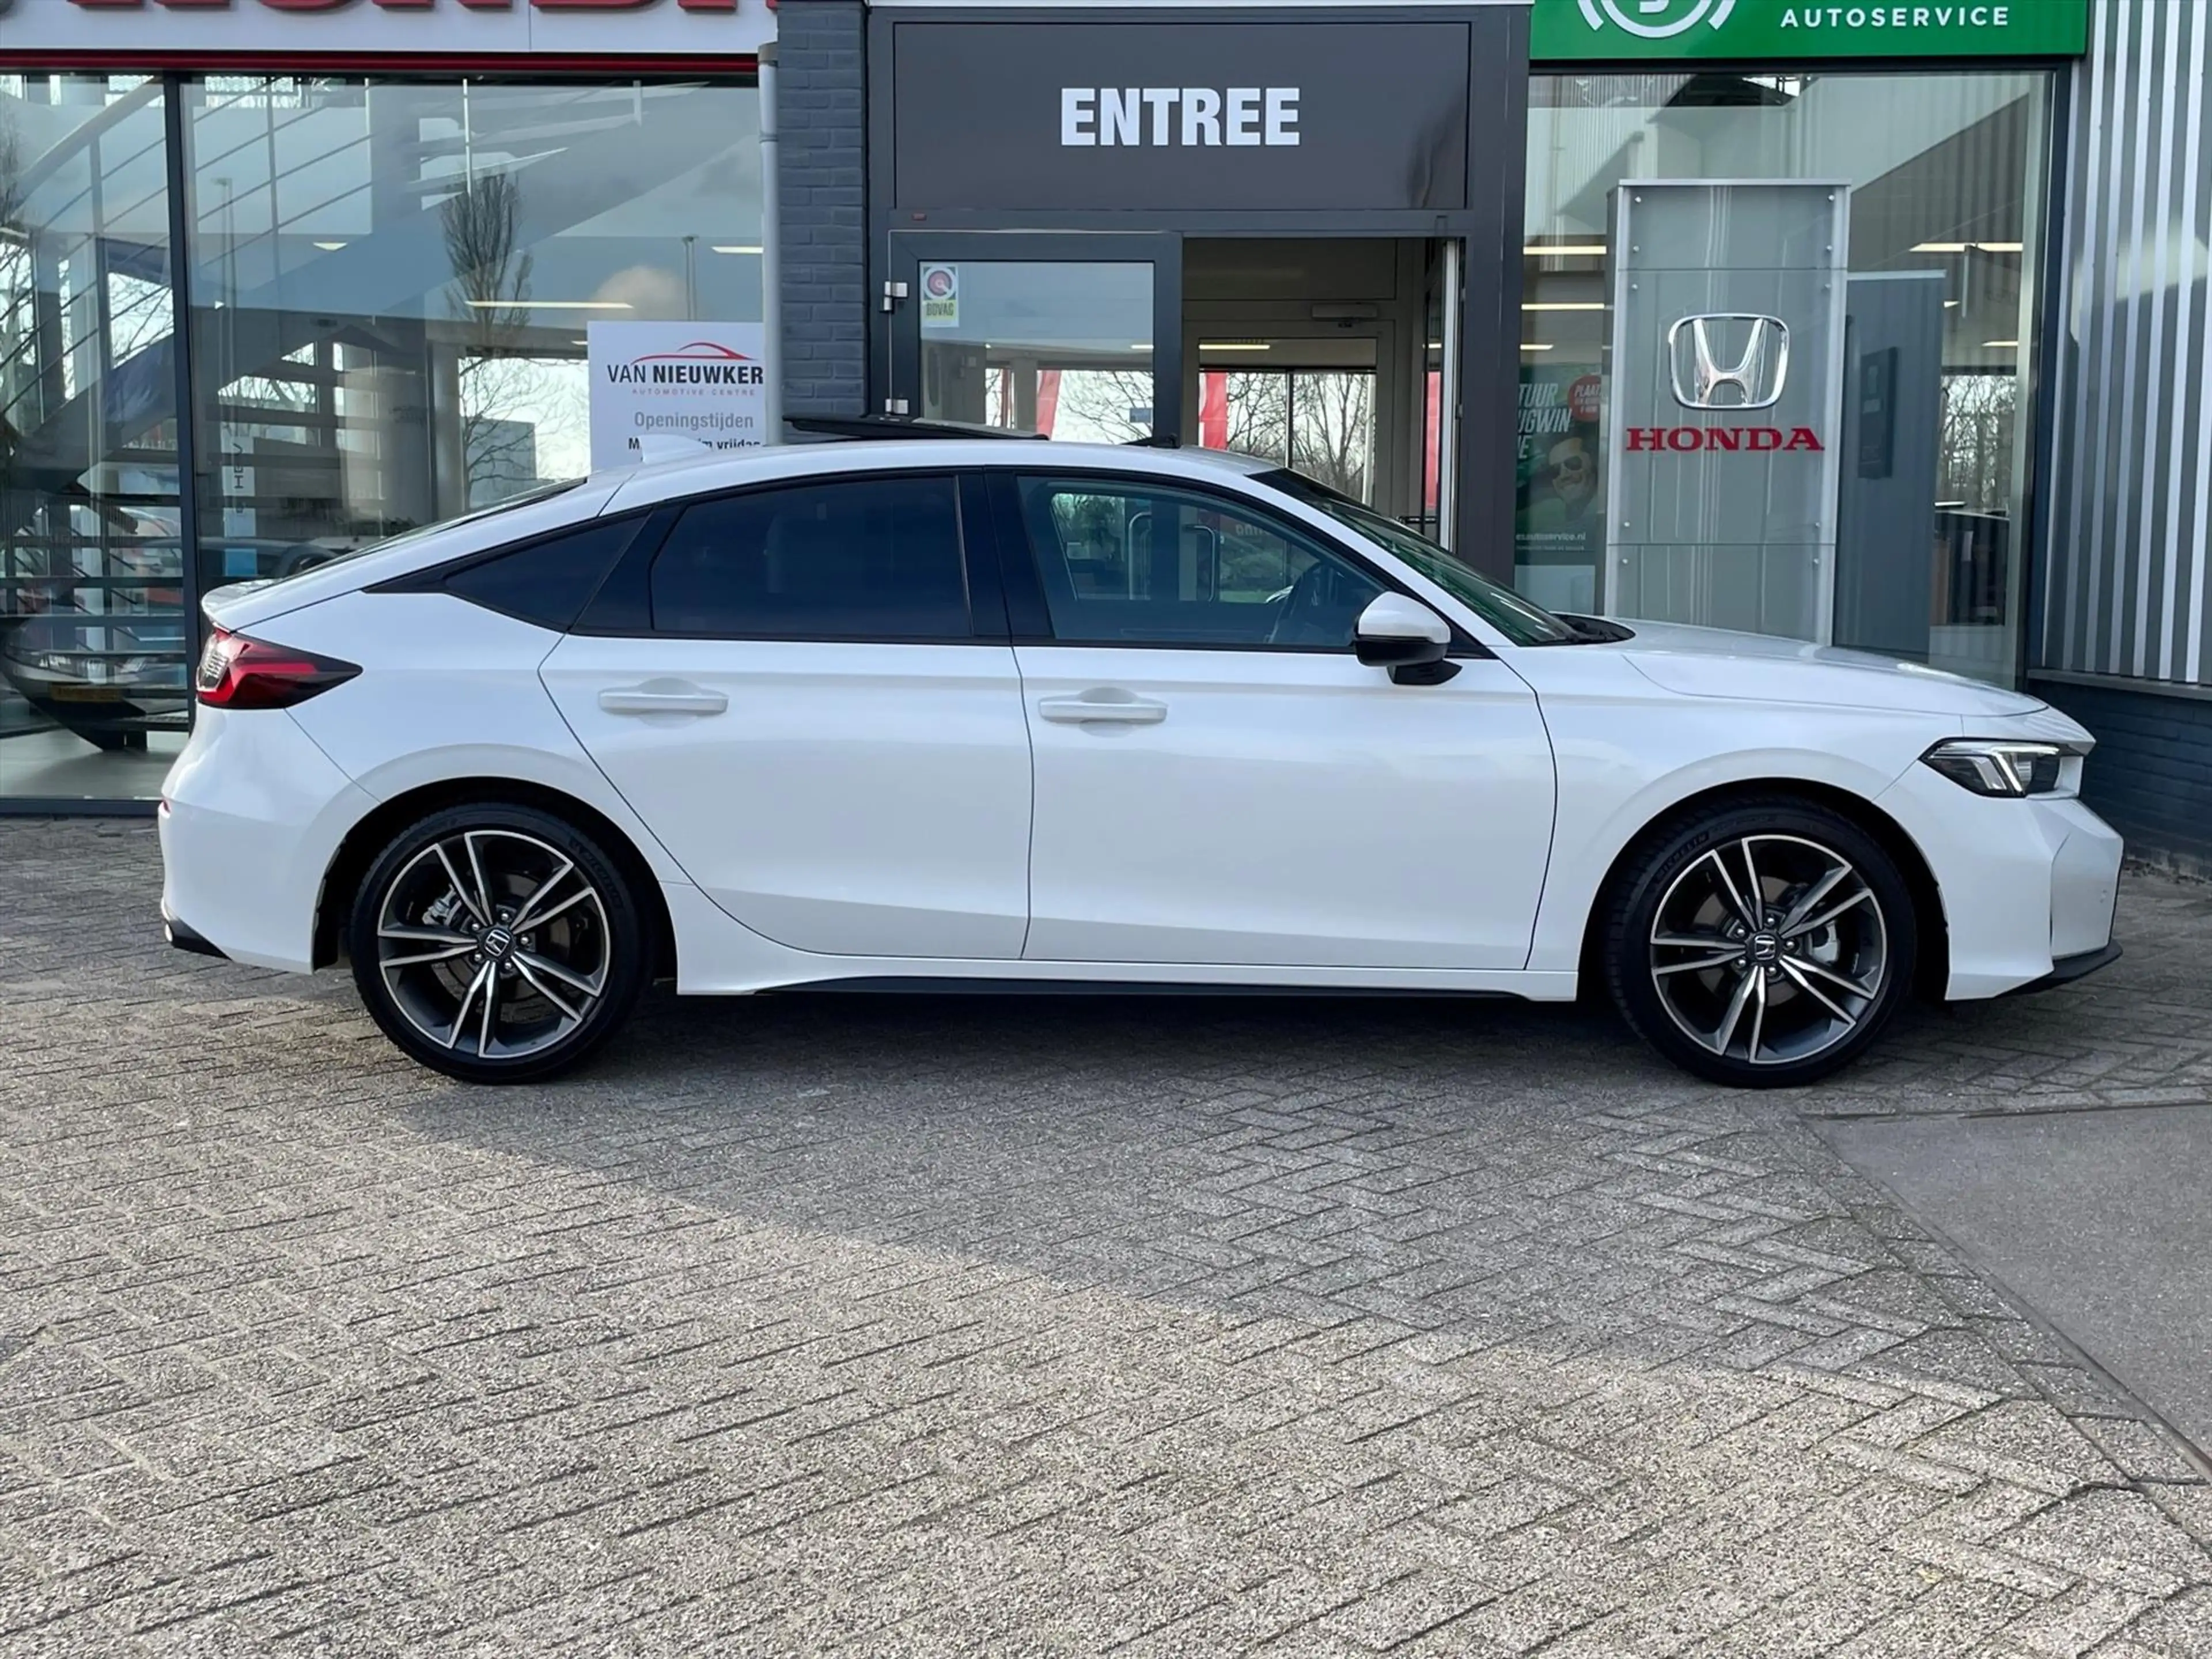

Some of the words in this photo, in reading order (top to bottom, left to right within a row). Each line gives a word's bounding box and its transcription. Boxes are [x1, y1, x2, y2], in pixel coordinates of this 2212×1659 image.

[1781, 6, 2009, 28] AUTOSERVICE
[1061, 88, 1300, 146] ENTREE
[607, 364, 646, 383] VAN
[653, 365, 764, 384] NIEUWKER
[711, 389, 756, 397] CENTRE
[634, 411, 754, 431] Openingstijden
[1626, 426, 1825, 452] HONDA
